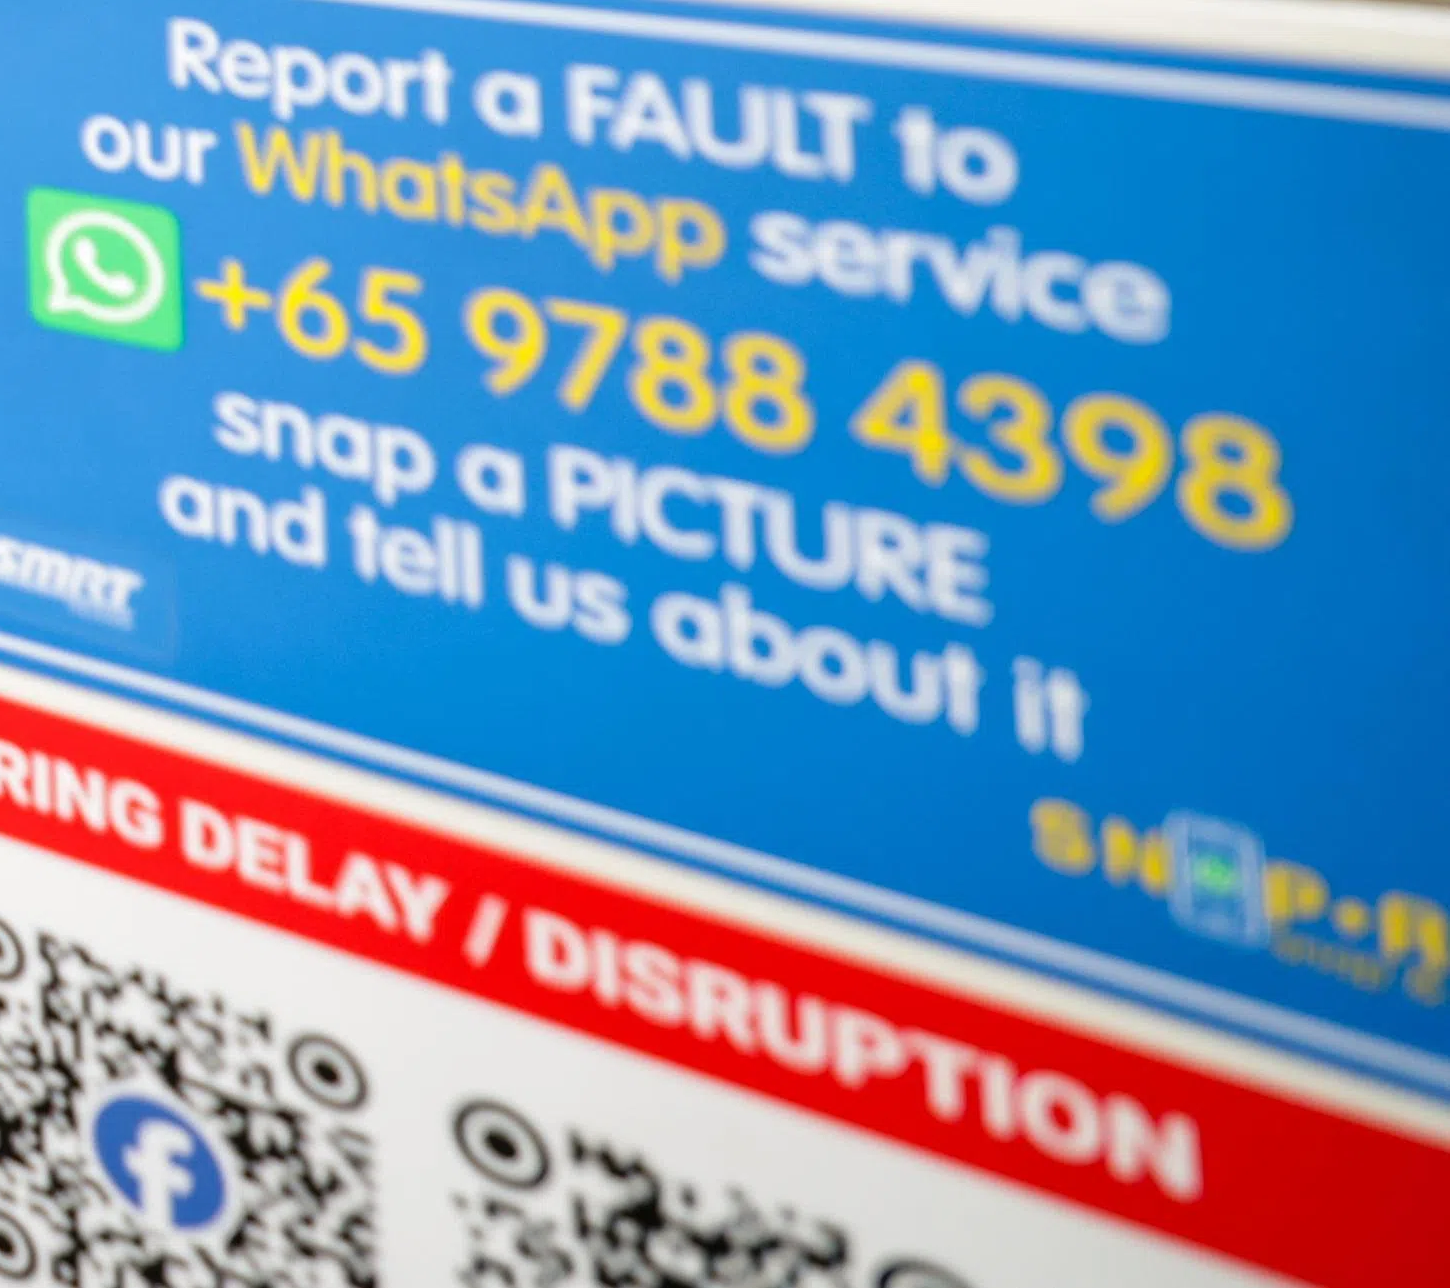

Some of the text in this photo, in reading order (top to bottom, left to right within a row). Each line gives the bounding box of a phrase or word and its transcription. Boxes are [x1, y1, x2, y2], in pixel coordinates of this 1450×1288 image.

[80, 114, 1167, 338] our WhatsApp service
[167, 17, 1016, 200] Report a FAULT to
[195, 257, 1289, 547] +65 9788 4398
[214, 392, 986, 621] snap a PICTURE
[158, 475, 1082, 757] and tell us about it
[180, 799, 446, 939] DELAY
[467, 898, 504, 962] /
[526, 911, 1198, 1195] DISRUPTION
